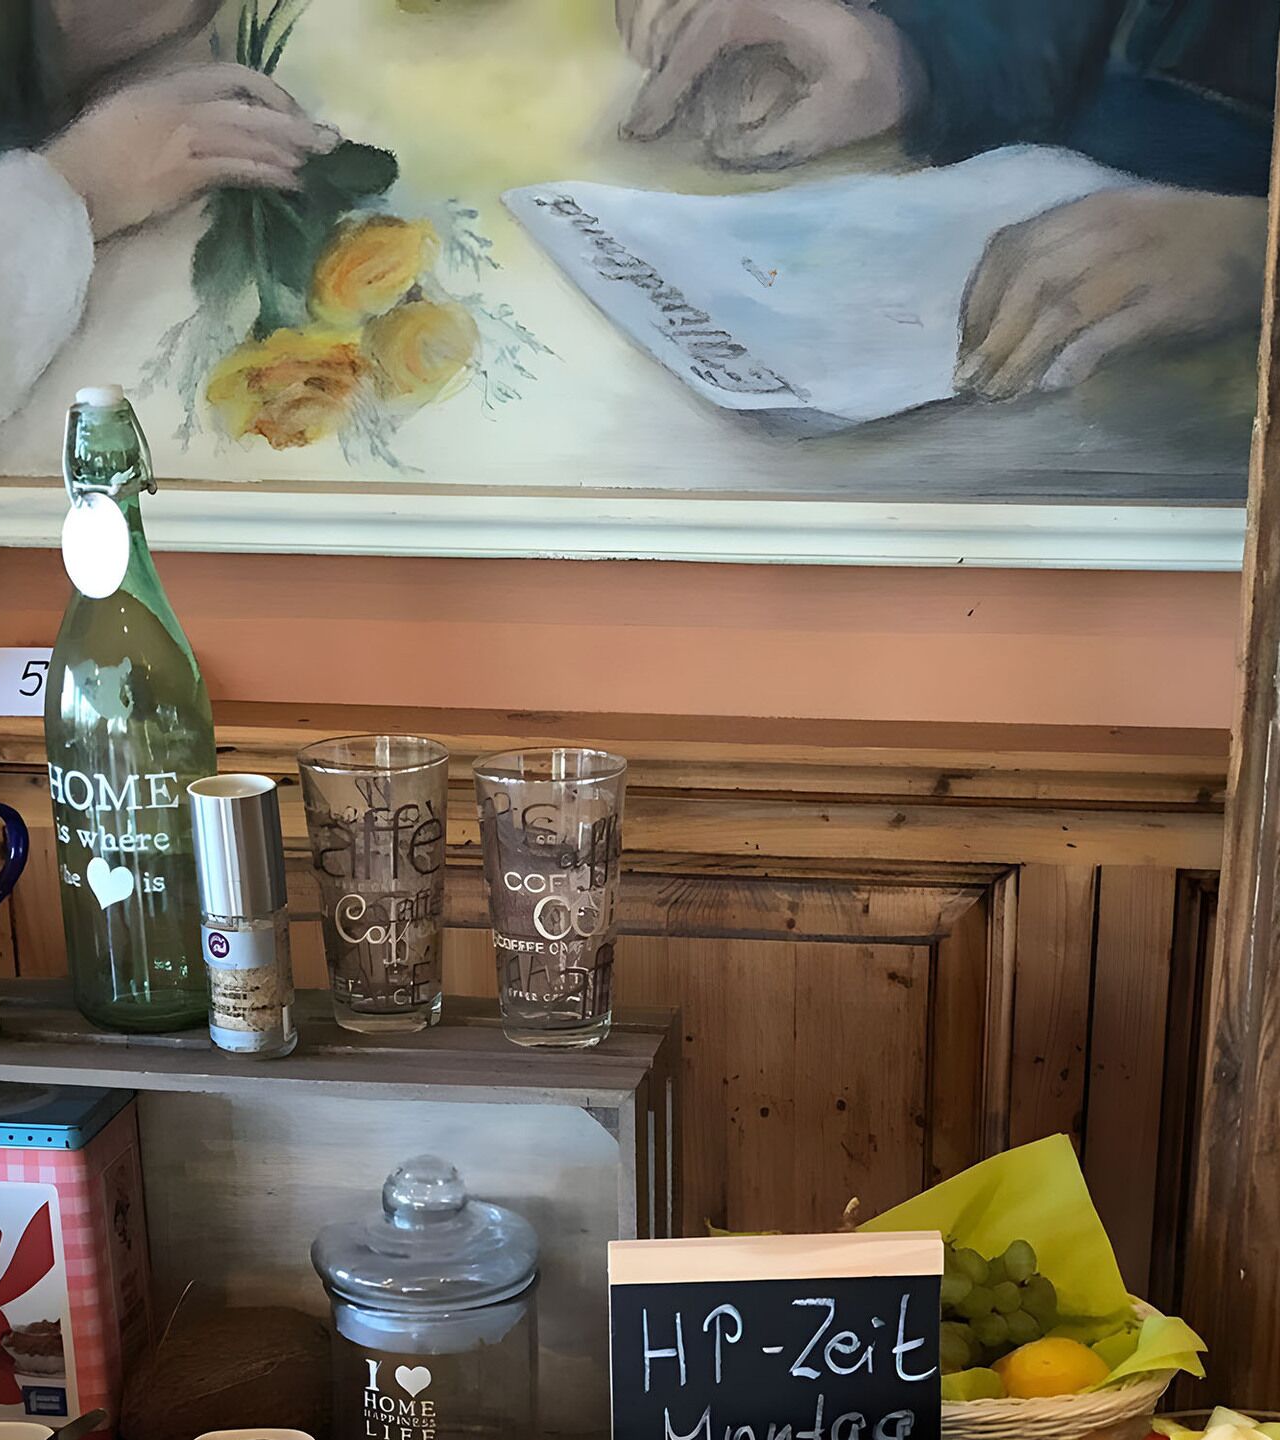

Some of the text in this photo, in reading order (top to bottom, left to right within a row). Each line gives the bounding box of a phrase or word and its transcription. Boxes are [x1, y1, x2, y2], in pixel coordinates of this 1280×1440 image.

[47, 761, 179, 811] HOME
[55, 816, 170, 853] is where
[143, 872, 166, 893] is
[364, 1358, 382, 1392] I
[363, 1391, 436, 1418] HOME
[364, 1409, 437, 1428] HAPPINESS
